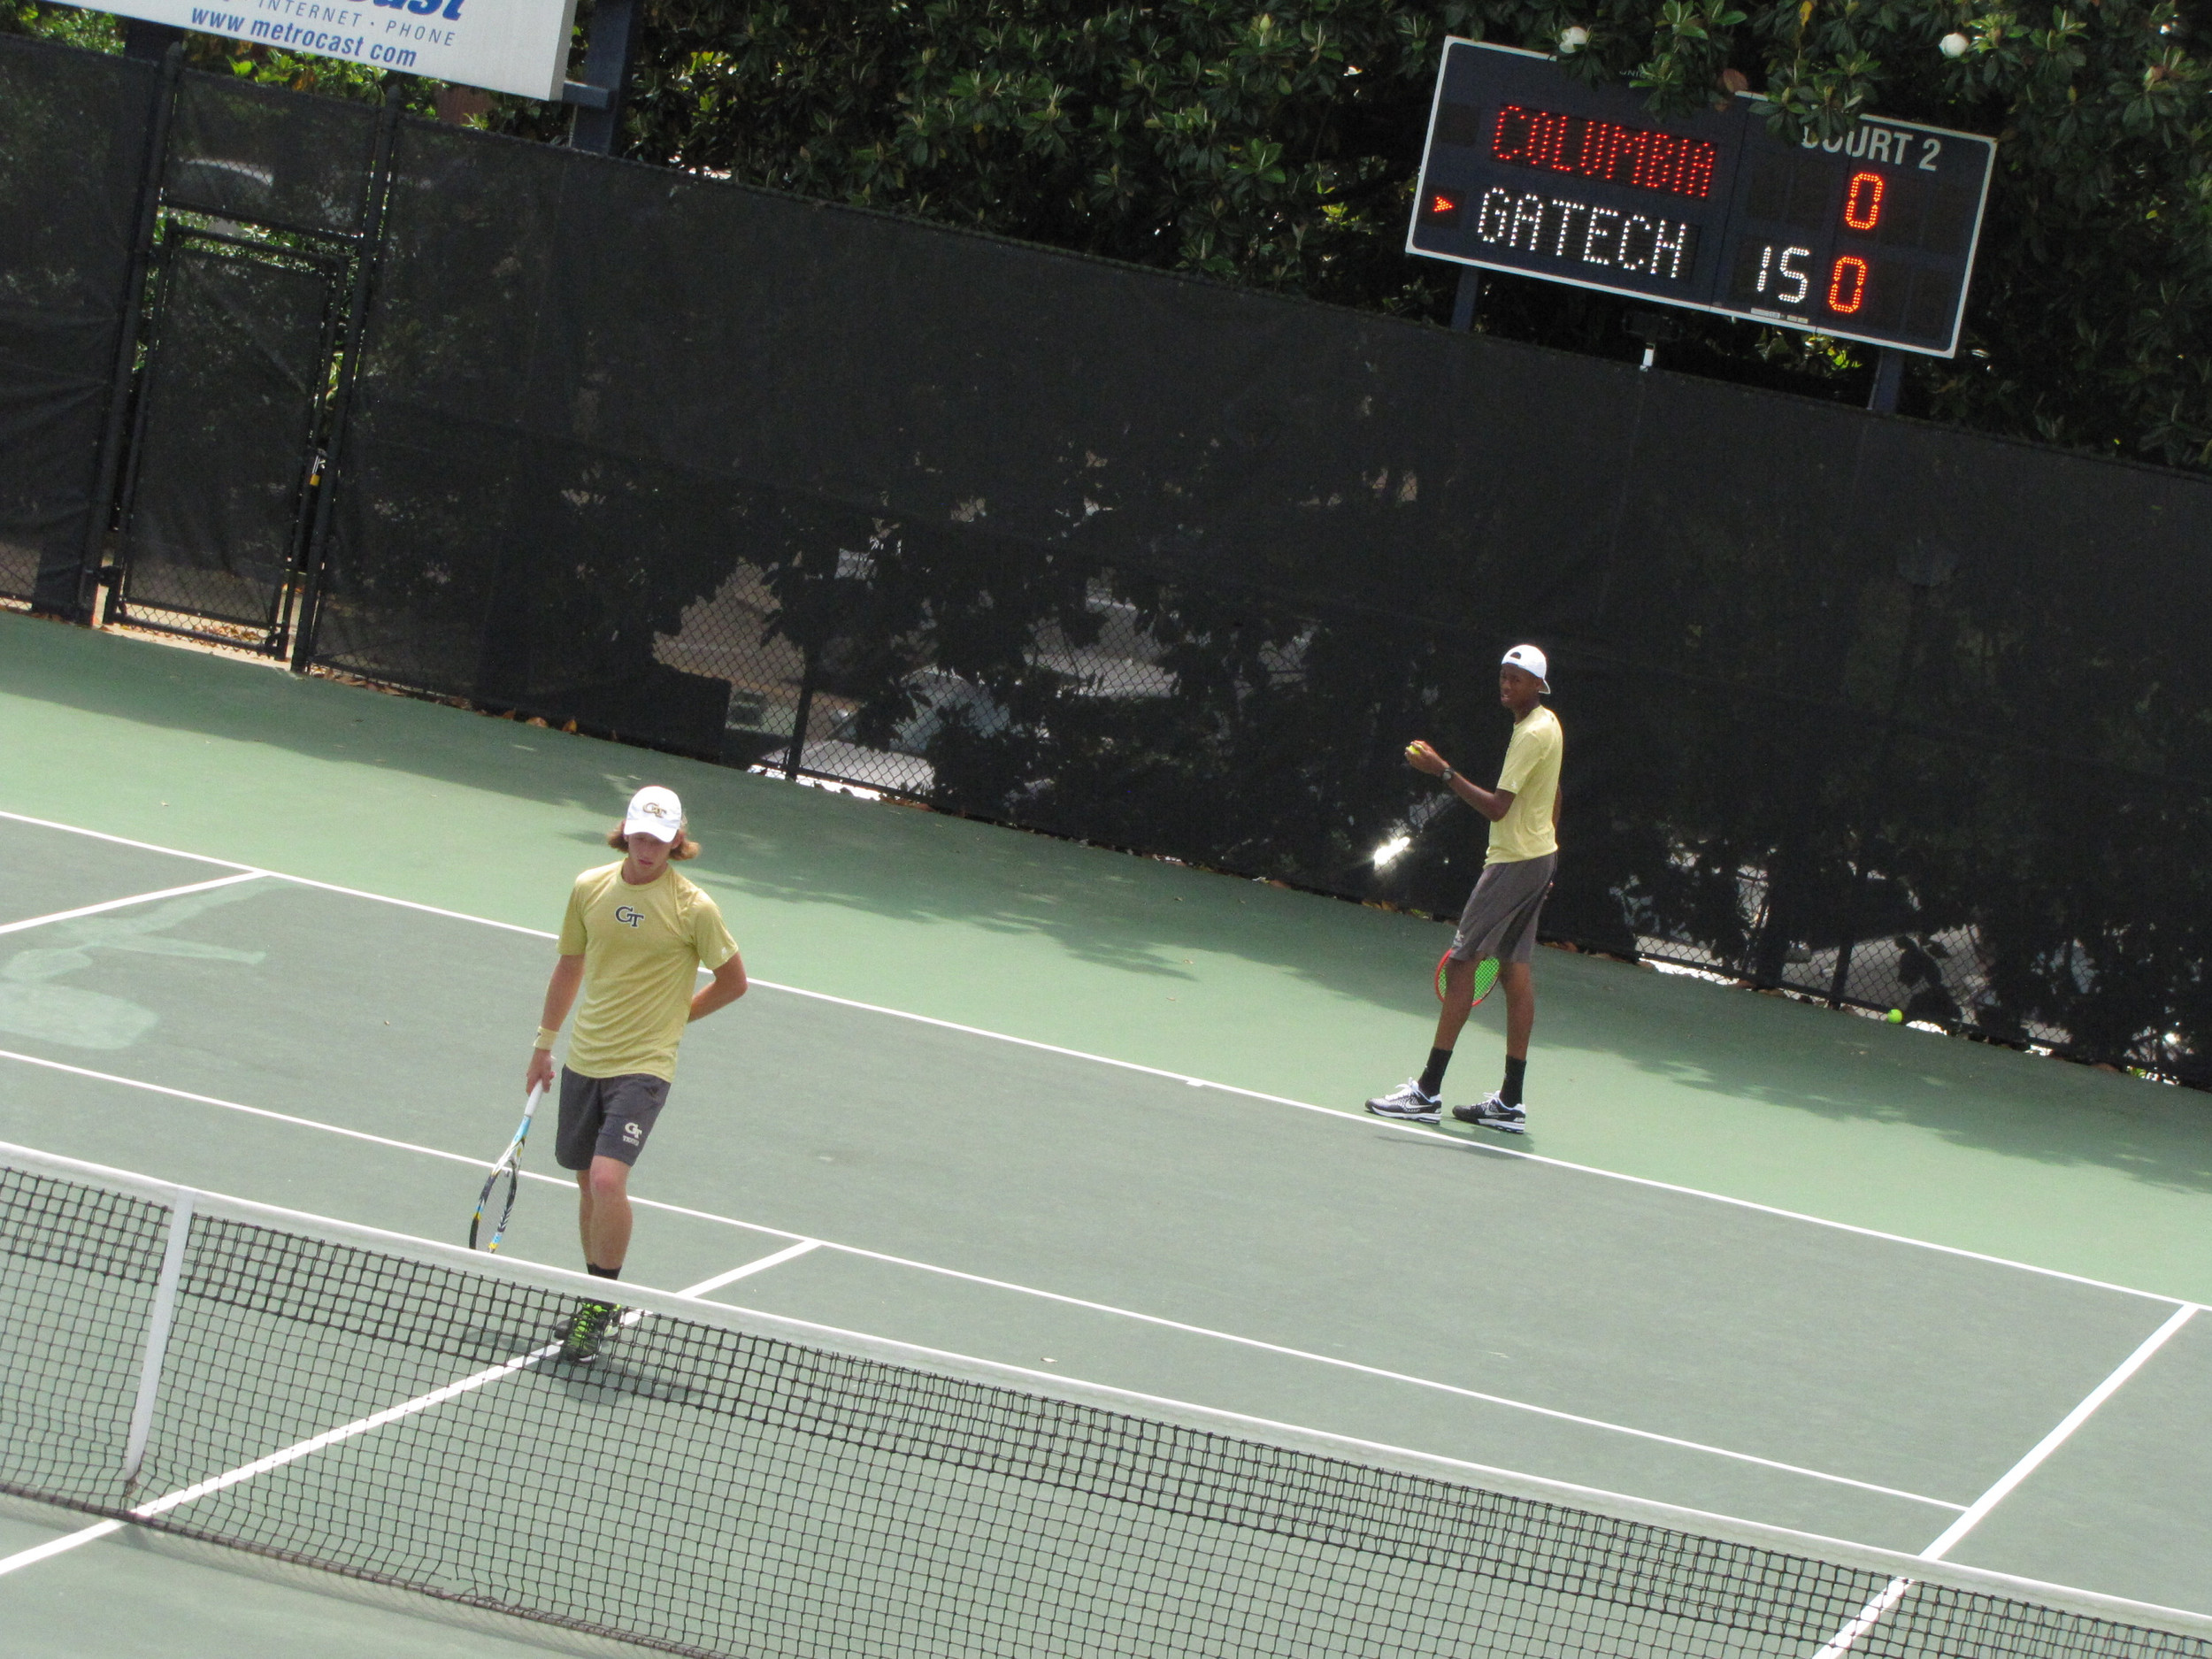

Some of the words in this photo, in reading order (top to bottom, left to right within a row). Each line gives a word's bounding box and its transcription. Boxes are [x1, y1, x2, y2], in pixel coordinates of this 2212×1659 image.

[258, 0, 362, 27] INTERNET
[386, 19, 456, 47] PHONE
[1492, 105, 1716, 197] COLUMBIA
[1845, 172, 1884, 230] 0
[1918, 138, 1941, 172] 2
[1478, 187, 1687, 279] GATECH
[1757, 246, 1810, 303] 15
[1829, 255, 1868, 313] 0
[615, 905, 645, 928] GT
